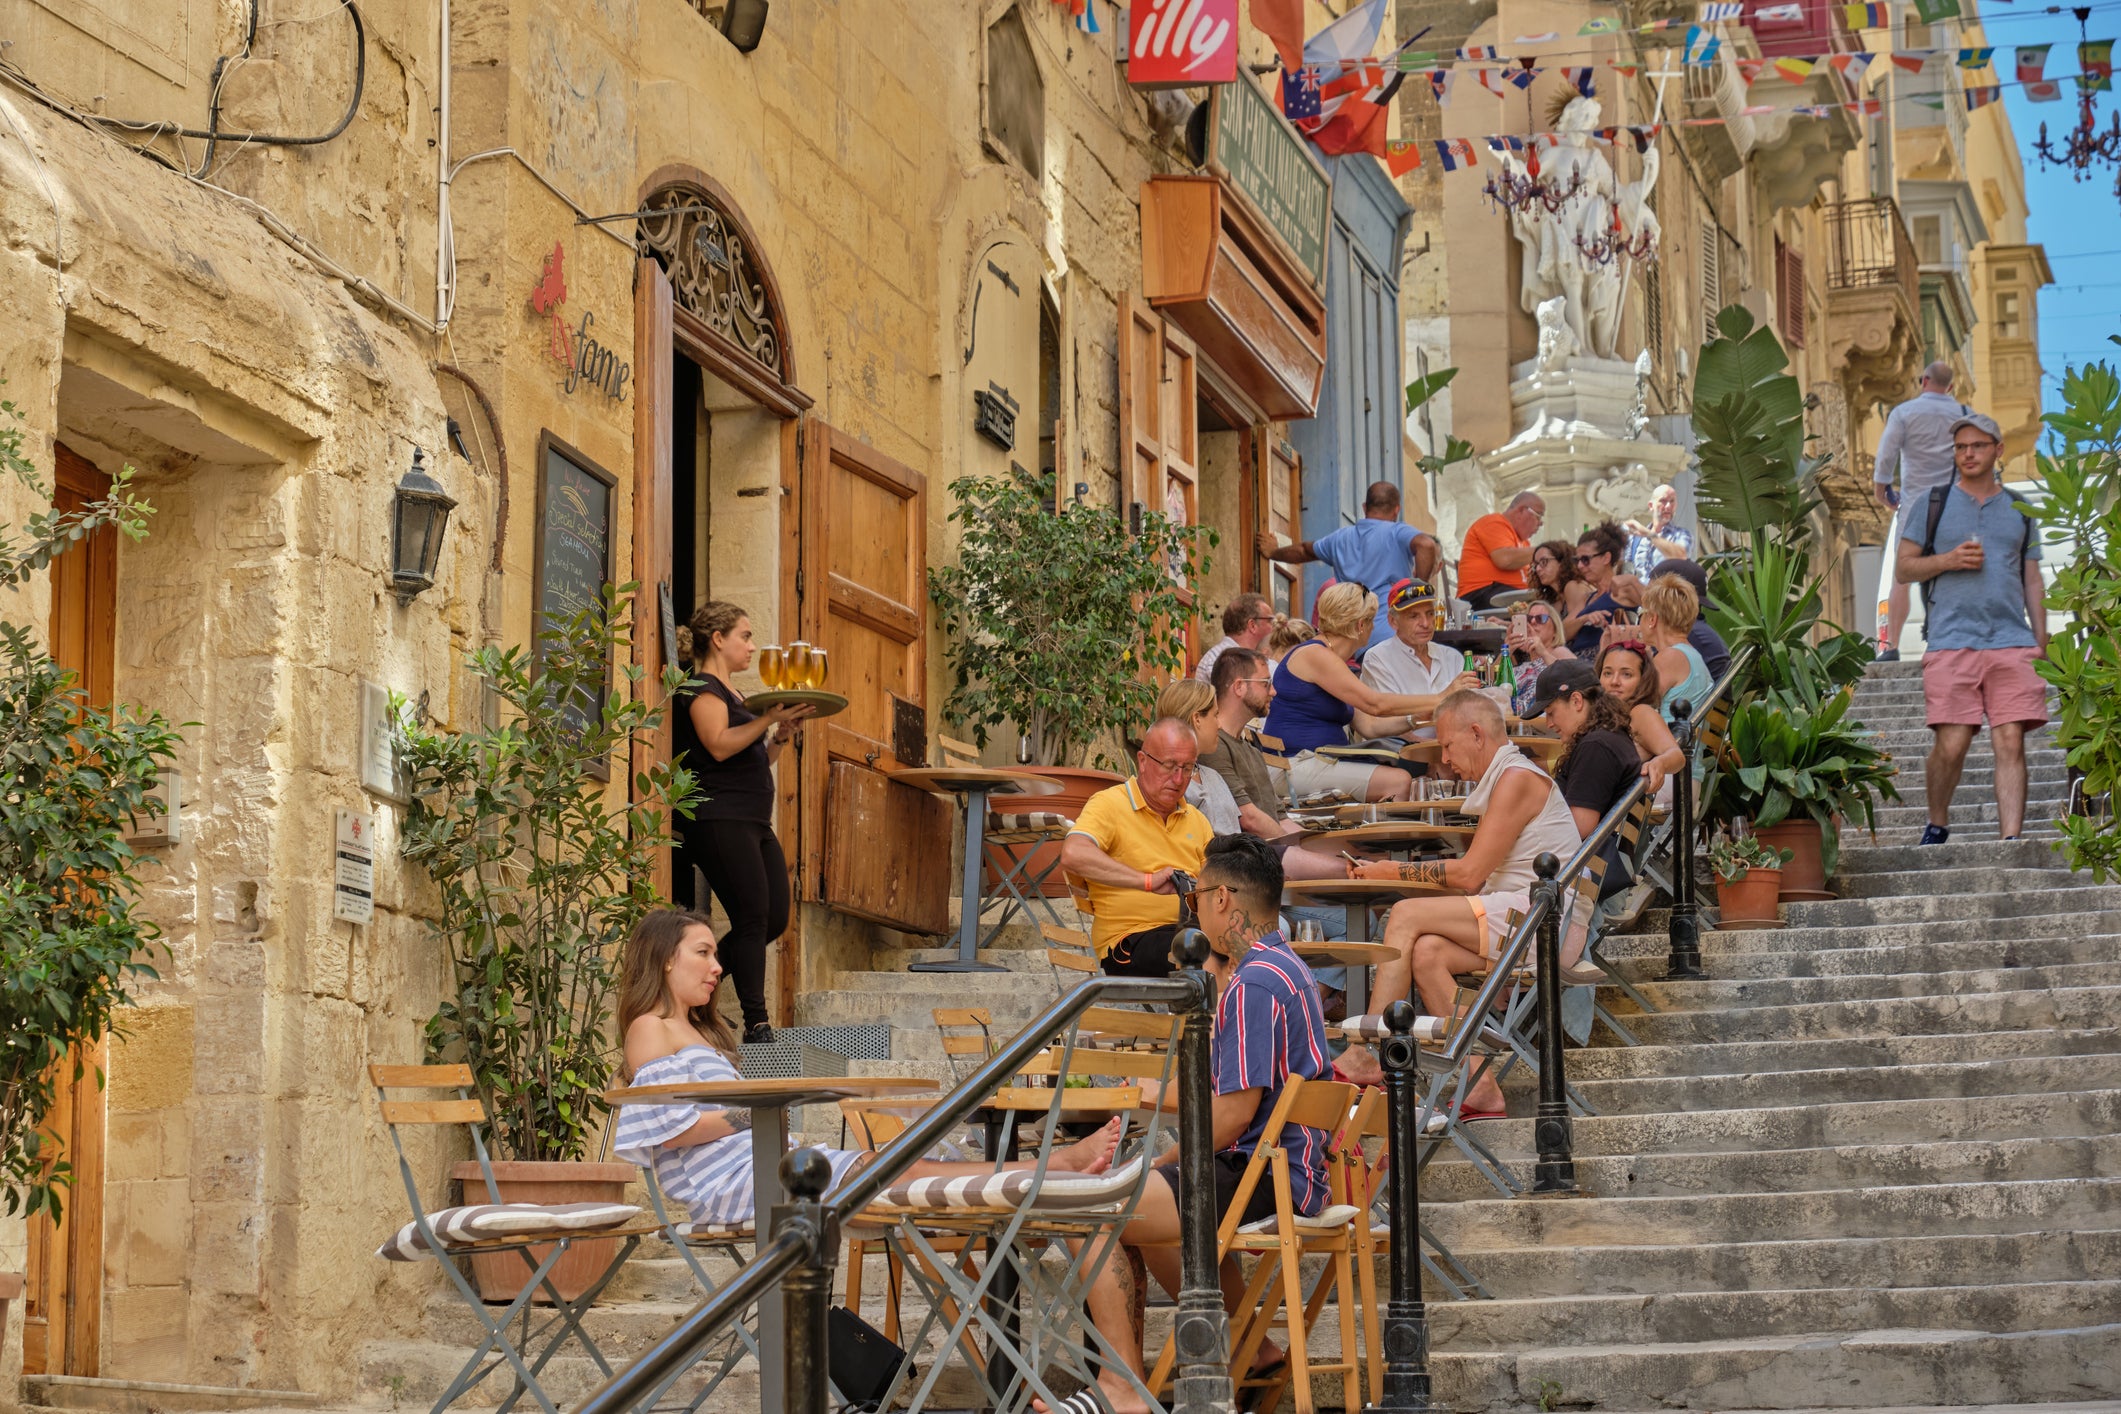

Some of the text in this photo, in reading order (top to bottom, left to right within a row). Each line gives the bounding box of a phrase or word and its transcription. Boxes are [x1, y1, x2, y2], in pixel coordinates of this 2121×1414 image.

[1134, 0, 1230, 73] illy
[1222, 79, 1324, 245] SAN PAOLO NAUFRAGO
[1240, 157, 1261, 201] WINE
[1271, 201, 1303, 255] SPIRITS
[564, 311, 630, 402] fame
